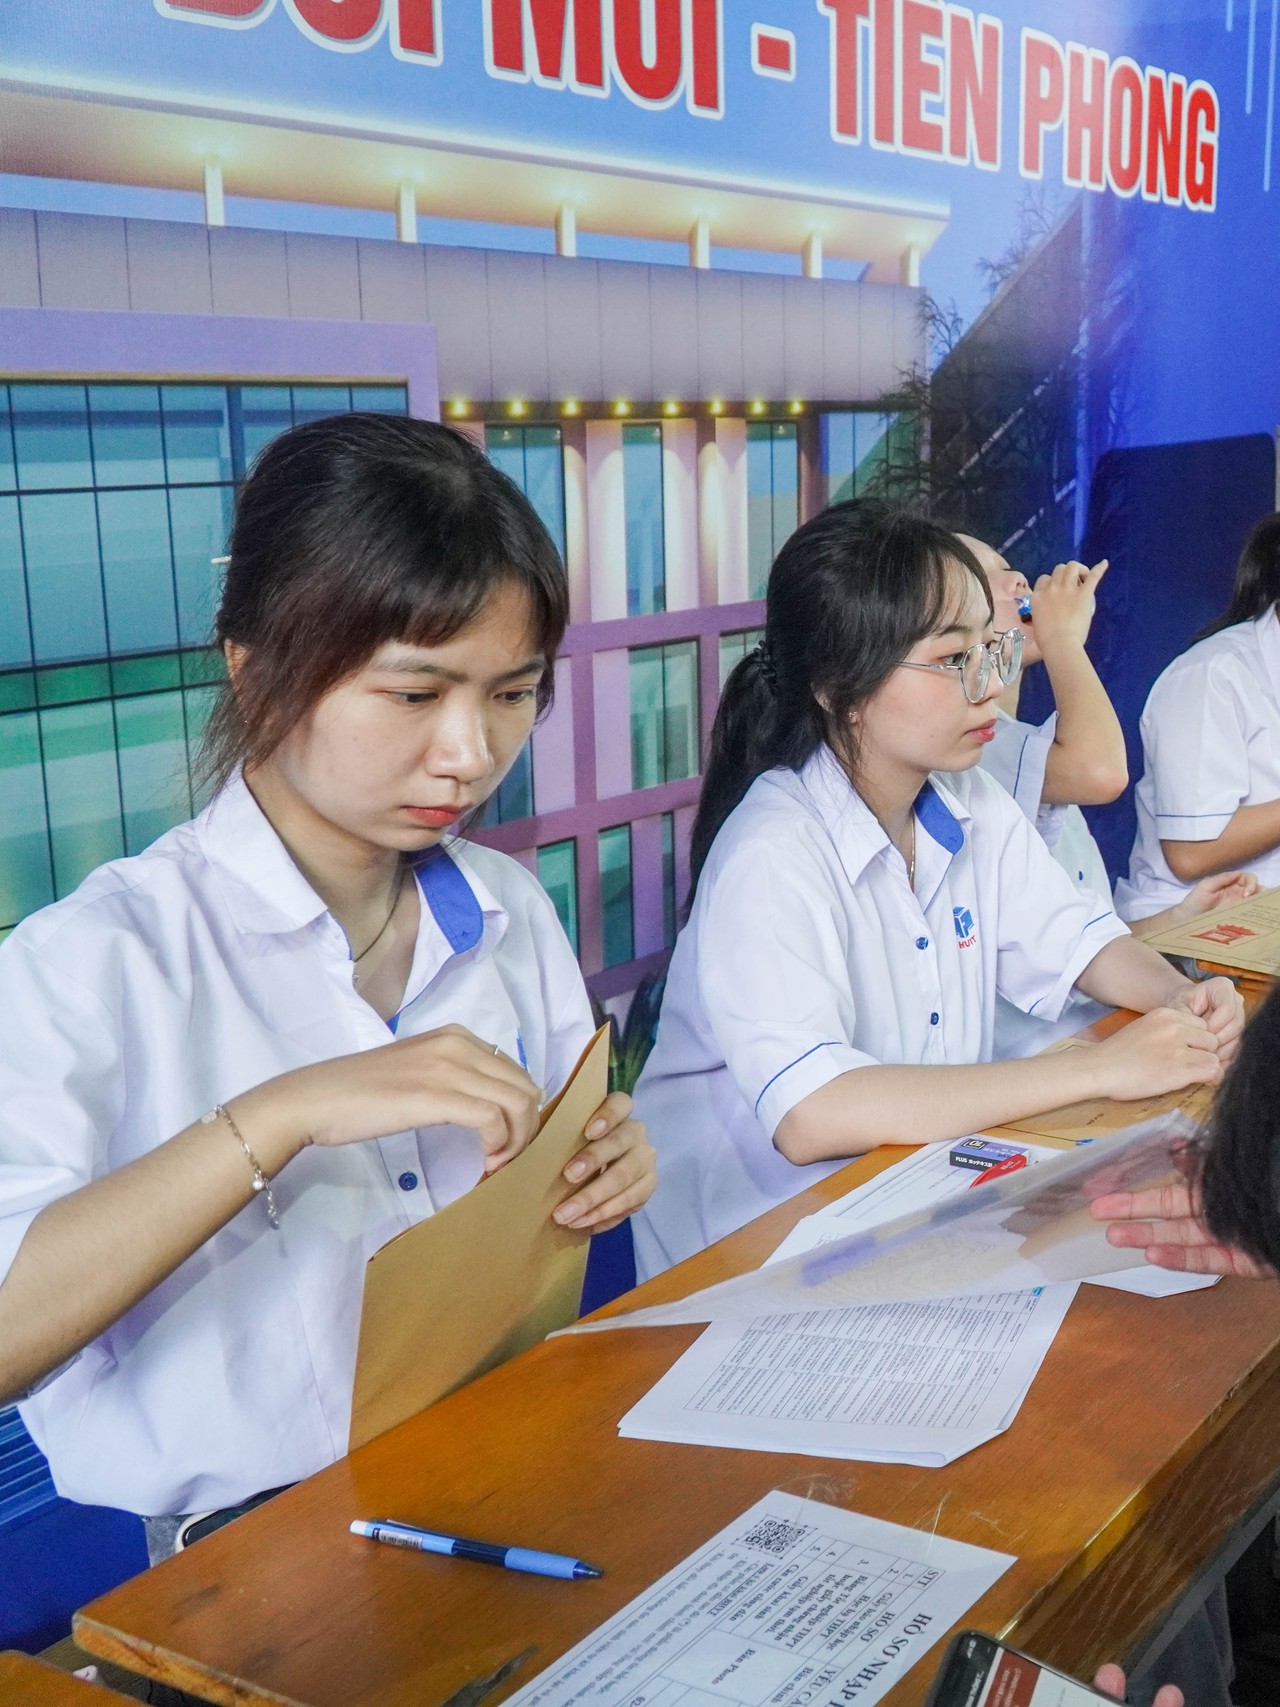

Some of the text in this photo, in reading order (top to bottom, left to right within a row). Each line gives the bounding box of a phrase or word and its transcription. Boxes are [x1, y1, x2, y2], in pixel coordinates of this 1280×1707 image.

[1022, 35, 1217, 206] PHONG
[958, 935, 977, 949] HUIT
[916, 1570, 939, 1587] STT
[785, 1627, 812, 1649] THPT
[820, 1618, 846, 1639] THPT
[711, 1663, 739, 1685] Photo
